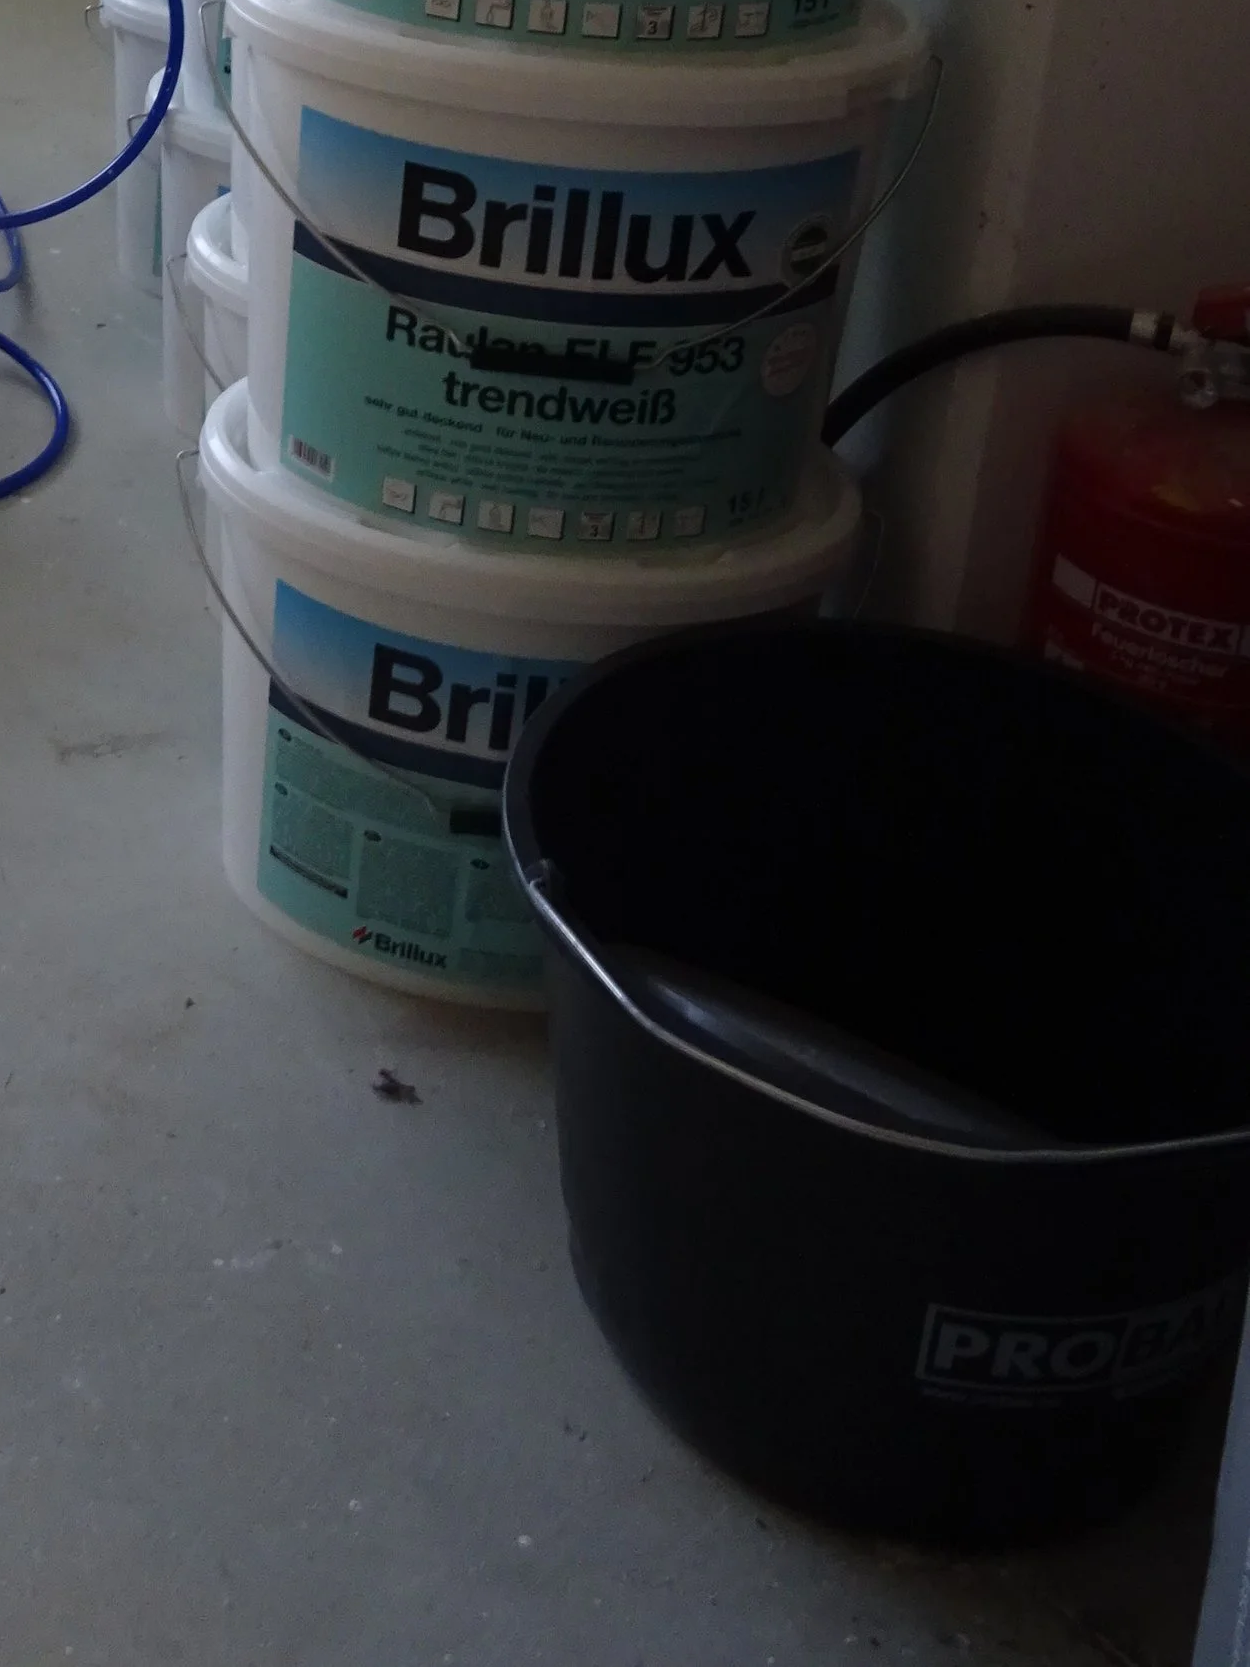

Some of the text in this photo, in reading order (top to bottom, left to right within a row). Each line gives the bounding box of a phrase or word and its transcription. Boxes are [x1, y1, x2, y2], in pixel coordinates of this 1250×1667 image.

[398, 161, 756, 283] Brillux
[668, 336, 744, 376] 953
[365, 395, 393, 411] sehr
[397, 405, 418, 419] gut
[496, 425, 518, 439] für
[560, 434, 587, 447] und
[443, 370, 676, 426] trendweiß
[1099, 590, 1234, 650] PROTEX
[369, 643, 568, 750] Bril
[374, 933, 448, 969] Brillux
